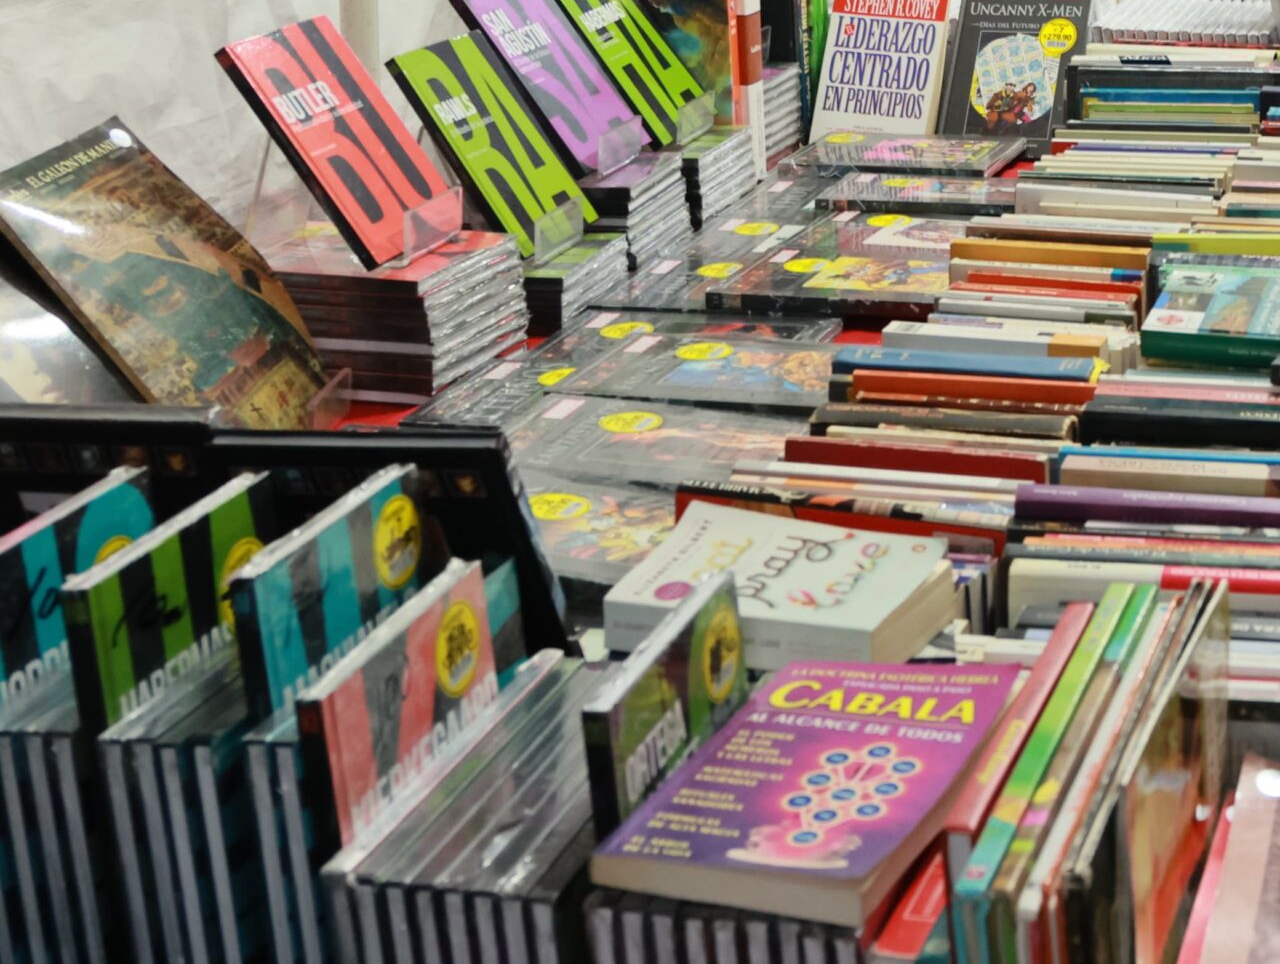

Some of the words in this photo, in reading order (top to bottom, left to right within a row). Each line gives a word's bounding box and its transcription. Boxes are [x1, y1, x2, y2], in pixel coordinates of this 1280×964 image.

[481, 8, 514, 37] SAN
[970, 1, 1036, 16] UNCANNY
[1037, 3, 1083, 17] X-MEN
[997, 21, 1010, 29] DEL
[1011, 21, 1040, 29] FUTURO
[499, 20, 552, 58] AGUSTÍN
[834, 15, 936, 56] LIDERAZGO
[828, 49, 930, 92] CENTRADO
[271, 80, 340, 124] BUTLER
[433, 93, 478, 126] RAWLS
[822, 85, 845, 112] EN
[844, 87, 925, 120] PRINCIPIOS
[25, 175, 41, 189] EL
[74, 151, 93, 165] DE
[86, 140, 118, 160] MANI
[733, 531, 856, 610] pray
[768, 679, 976, 726] CABALA
[746, 712, 768, 723] AL
[772, 714, 861, 735] ALCANCE
[864, 722, 893, 736] DE
[896, 725, 964, 744] TODOS
